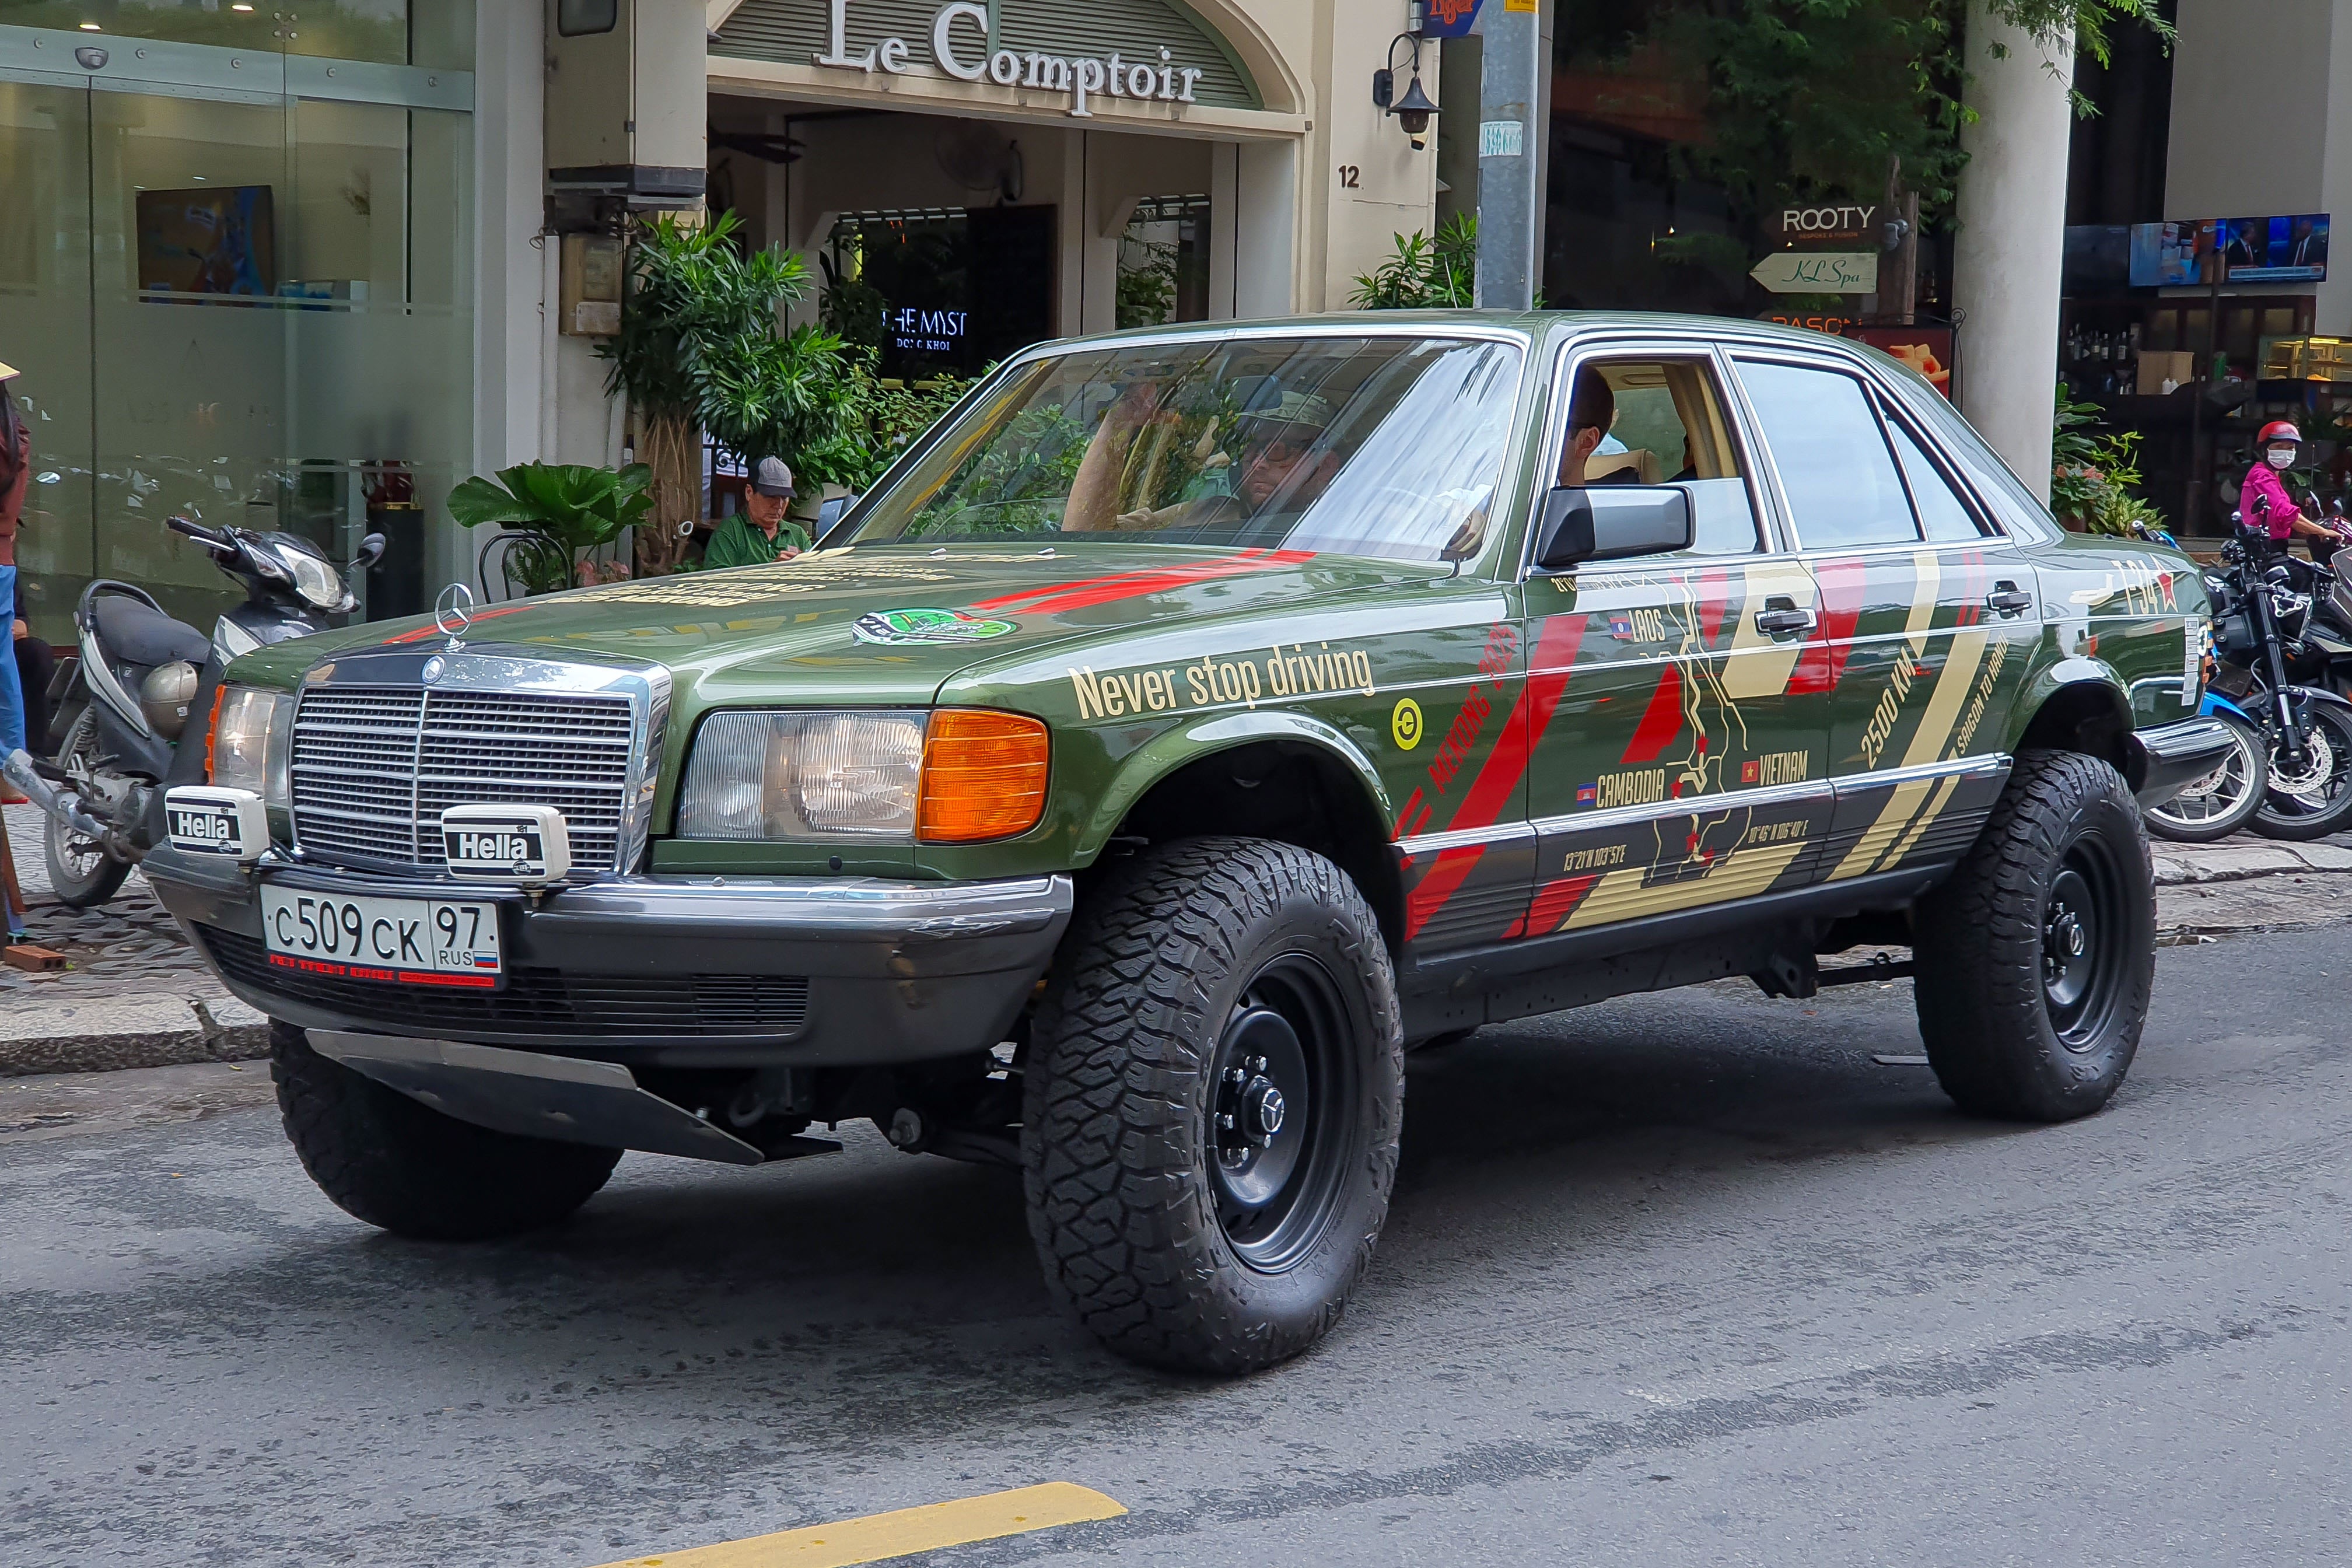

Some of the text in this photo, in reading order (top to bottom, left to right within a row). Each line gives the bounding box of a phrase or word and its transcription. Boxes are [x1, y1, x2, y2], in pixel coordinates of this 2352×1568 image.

[1429, 0, 1475, 24] Tiger
[817, 0, 1203, 117] Le Comptoir
[1338, 165, 1360, 189] 12
[1783, 206, 1876, 232] ROOTY
[1782, 260, 1860, 288] KL Spa
[926, 340, 950, 351] KHOI
[1628, 608, 1665, 642] LAOS
[1067, 642, 1376, 719] Never stop driving
[1957, 629, 2009, 755] SAIGON TO HANOI
[1861, 646, 1916, 771] 2500 KM
[1428, 684, 1491, 795] MEKONG
[1760, 750, 1808, 786] VIETNAM
[1596, 768, 1665, 808] CAMBODIA
[178, 812, 230, 839] Hella
[459, 833, 528, 859] Hella
[436, 905, 480, 949] 97
[439, 950, 473, 967] RUS
